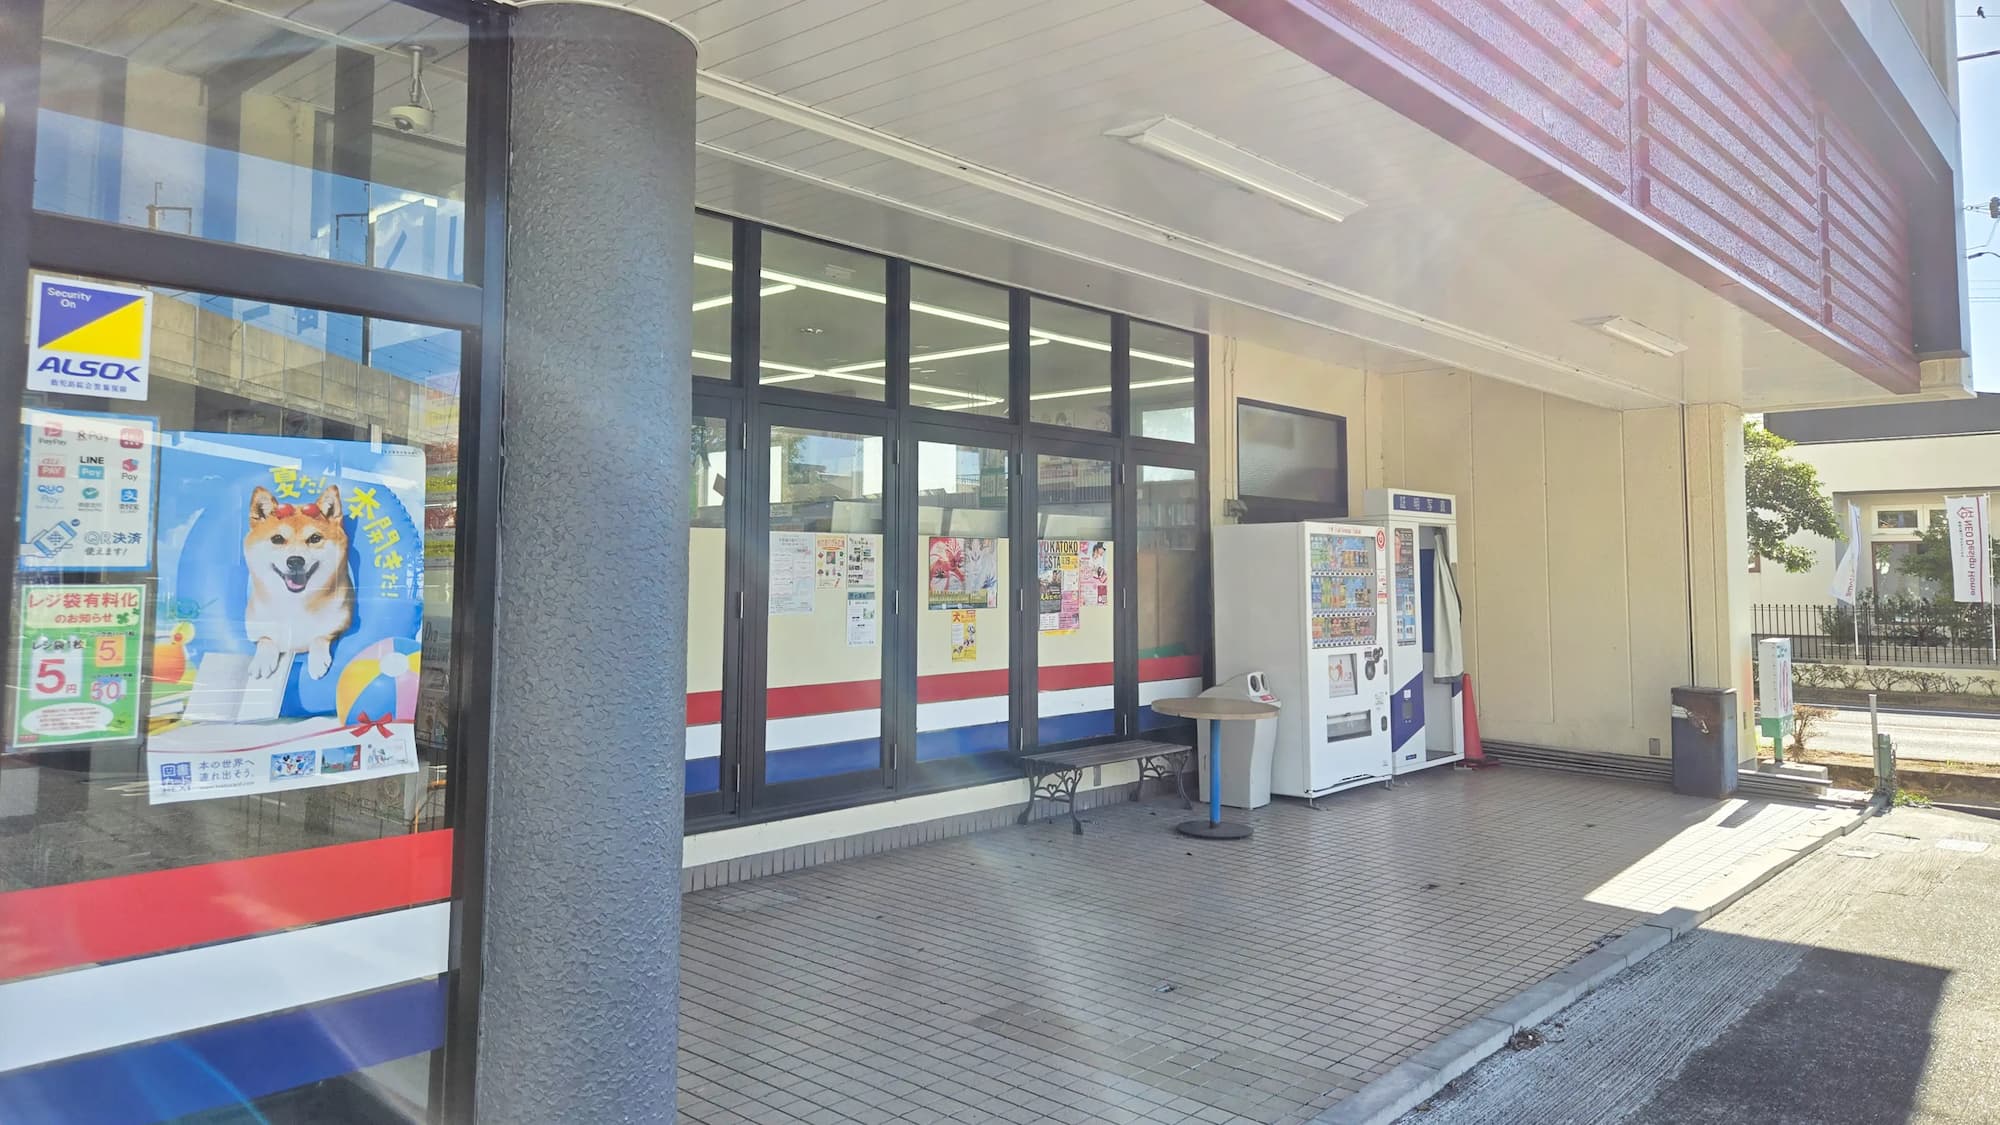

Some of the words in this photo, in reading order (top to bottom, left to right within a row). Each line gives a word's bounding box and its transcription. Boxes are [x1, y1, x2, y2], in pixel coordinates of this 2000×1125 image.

[47, 287, 91, 302] Security
[60, 298, 76, 309] On
[36, 356, 142, 382] ALSOK
[79, 456, 104, 465] LINE
[42, 467, 62, 475] PAY
[81, 468, 102, 479] Pay
[121, 472, 138, 482] Pay
[37, 485, 65, 495] QUO
[29, 592, 138, 609] レジ袋有料化
[55, 613, 113, 624] のお知らせ
[199, 757, 255, 770] 本の世界へ
